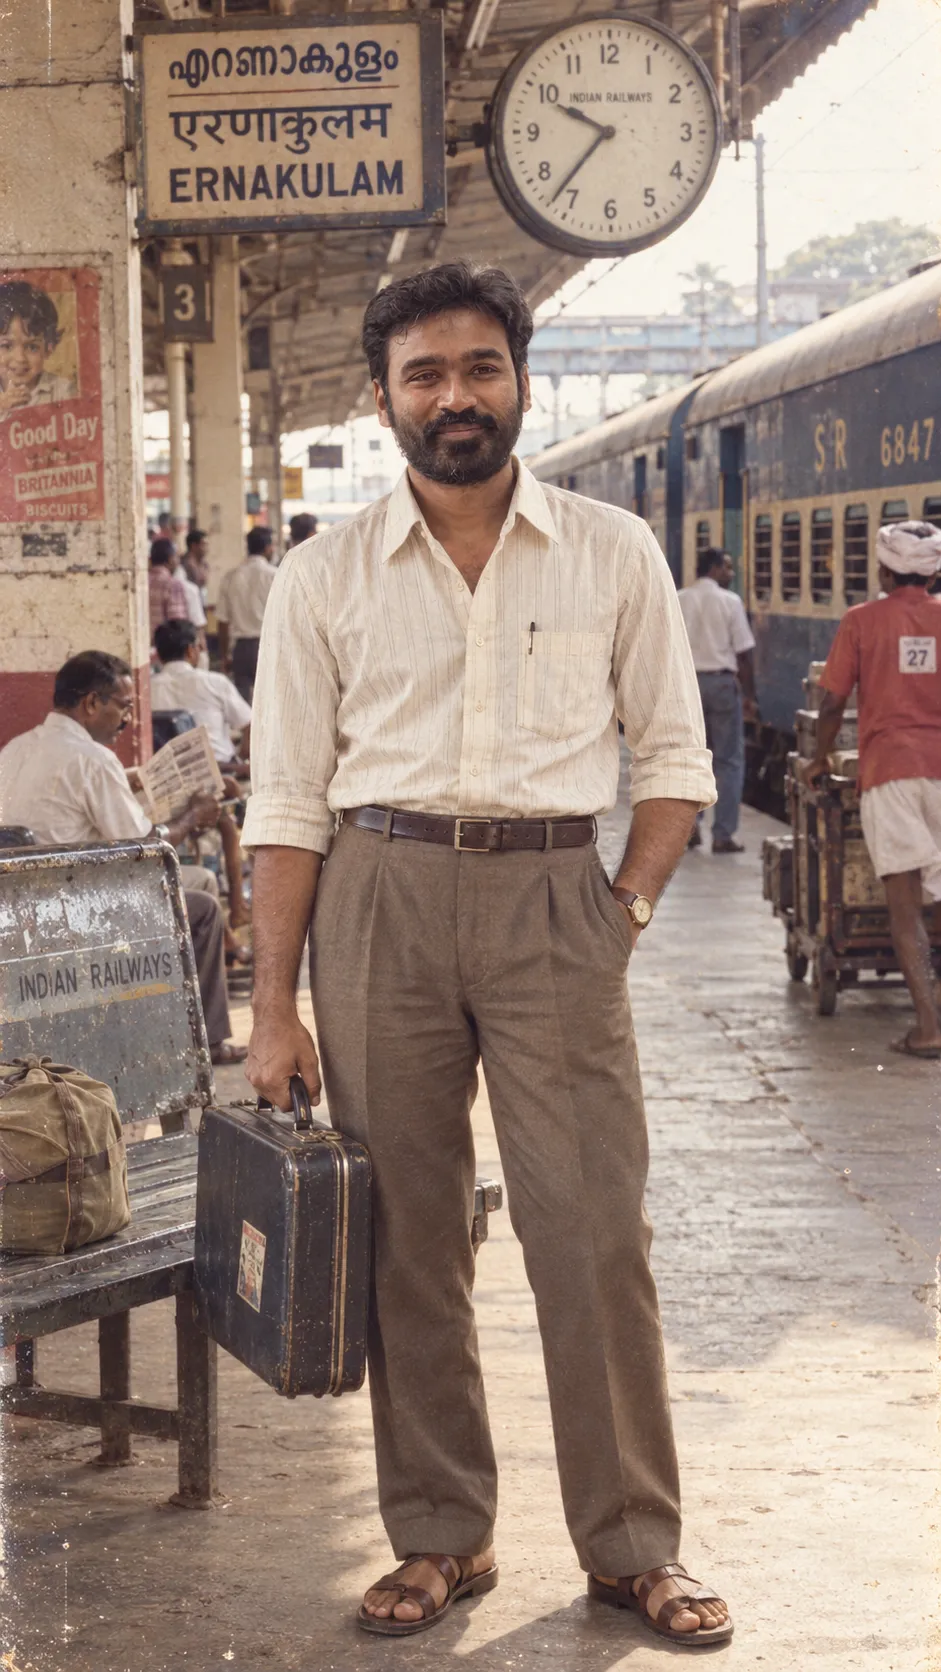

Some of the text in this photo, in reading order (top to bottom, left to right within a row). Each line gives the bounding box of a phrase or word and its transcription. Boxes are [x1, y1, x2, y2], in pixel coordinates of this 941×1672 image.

[566, 54, 581, 74] 11
[600, 44, 620, 64] 12
[646, 55, 652, 75] 1
[539, 83, 559, 104] 10
[569, 92, 652, 103] INDIAN RAILWAYS
[669, 84, 681, 104] 2
[169, 103, 392, 155] एरणाकुलम
[527, 123, 540, 142] 9
[680, 123, 692, 142] 3
[538, 161, 551, 181] 8
[669, 160, 683, 180] 4
[169, 160, 404, 203] ERNAKULAM
[566, 189, 579, 209] 7
[644, 188, 656, 207] 5
[604, 199, 617, 220] 6
[173, 284, 196, 321] 3
[9, 412, 98, 449] Good Day
[881, 417, 935, 467] 6847
[18, 467, 94, 495] BRITANNIA
[26, 503, 88, 517] BISCUITS
[907, 650, 928, 666] 27
[19, 952, 173, 1001] INDIAN RAILWAYS
